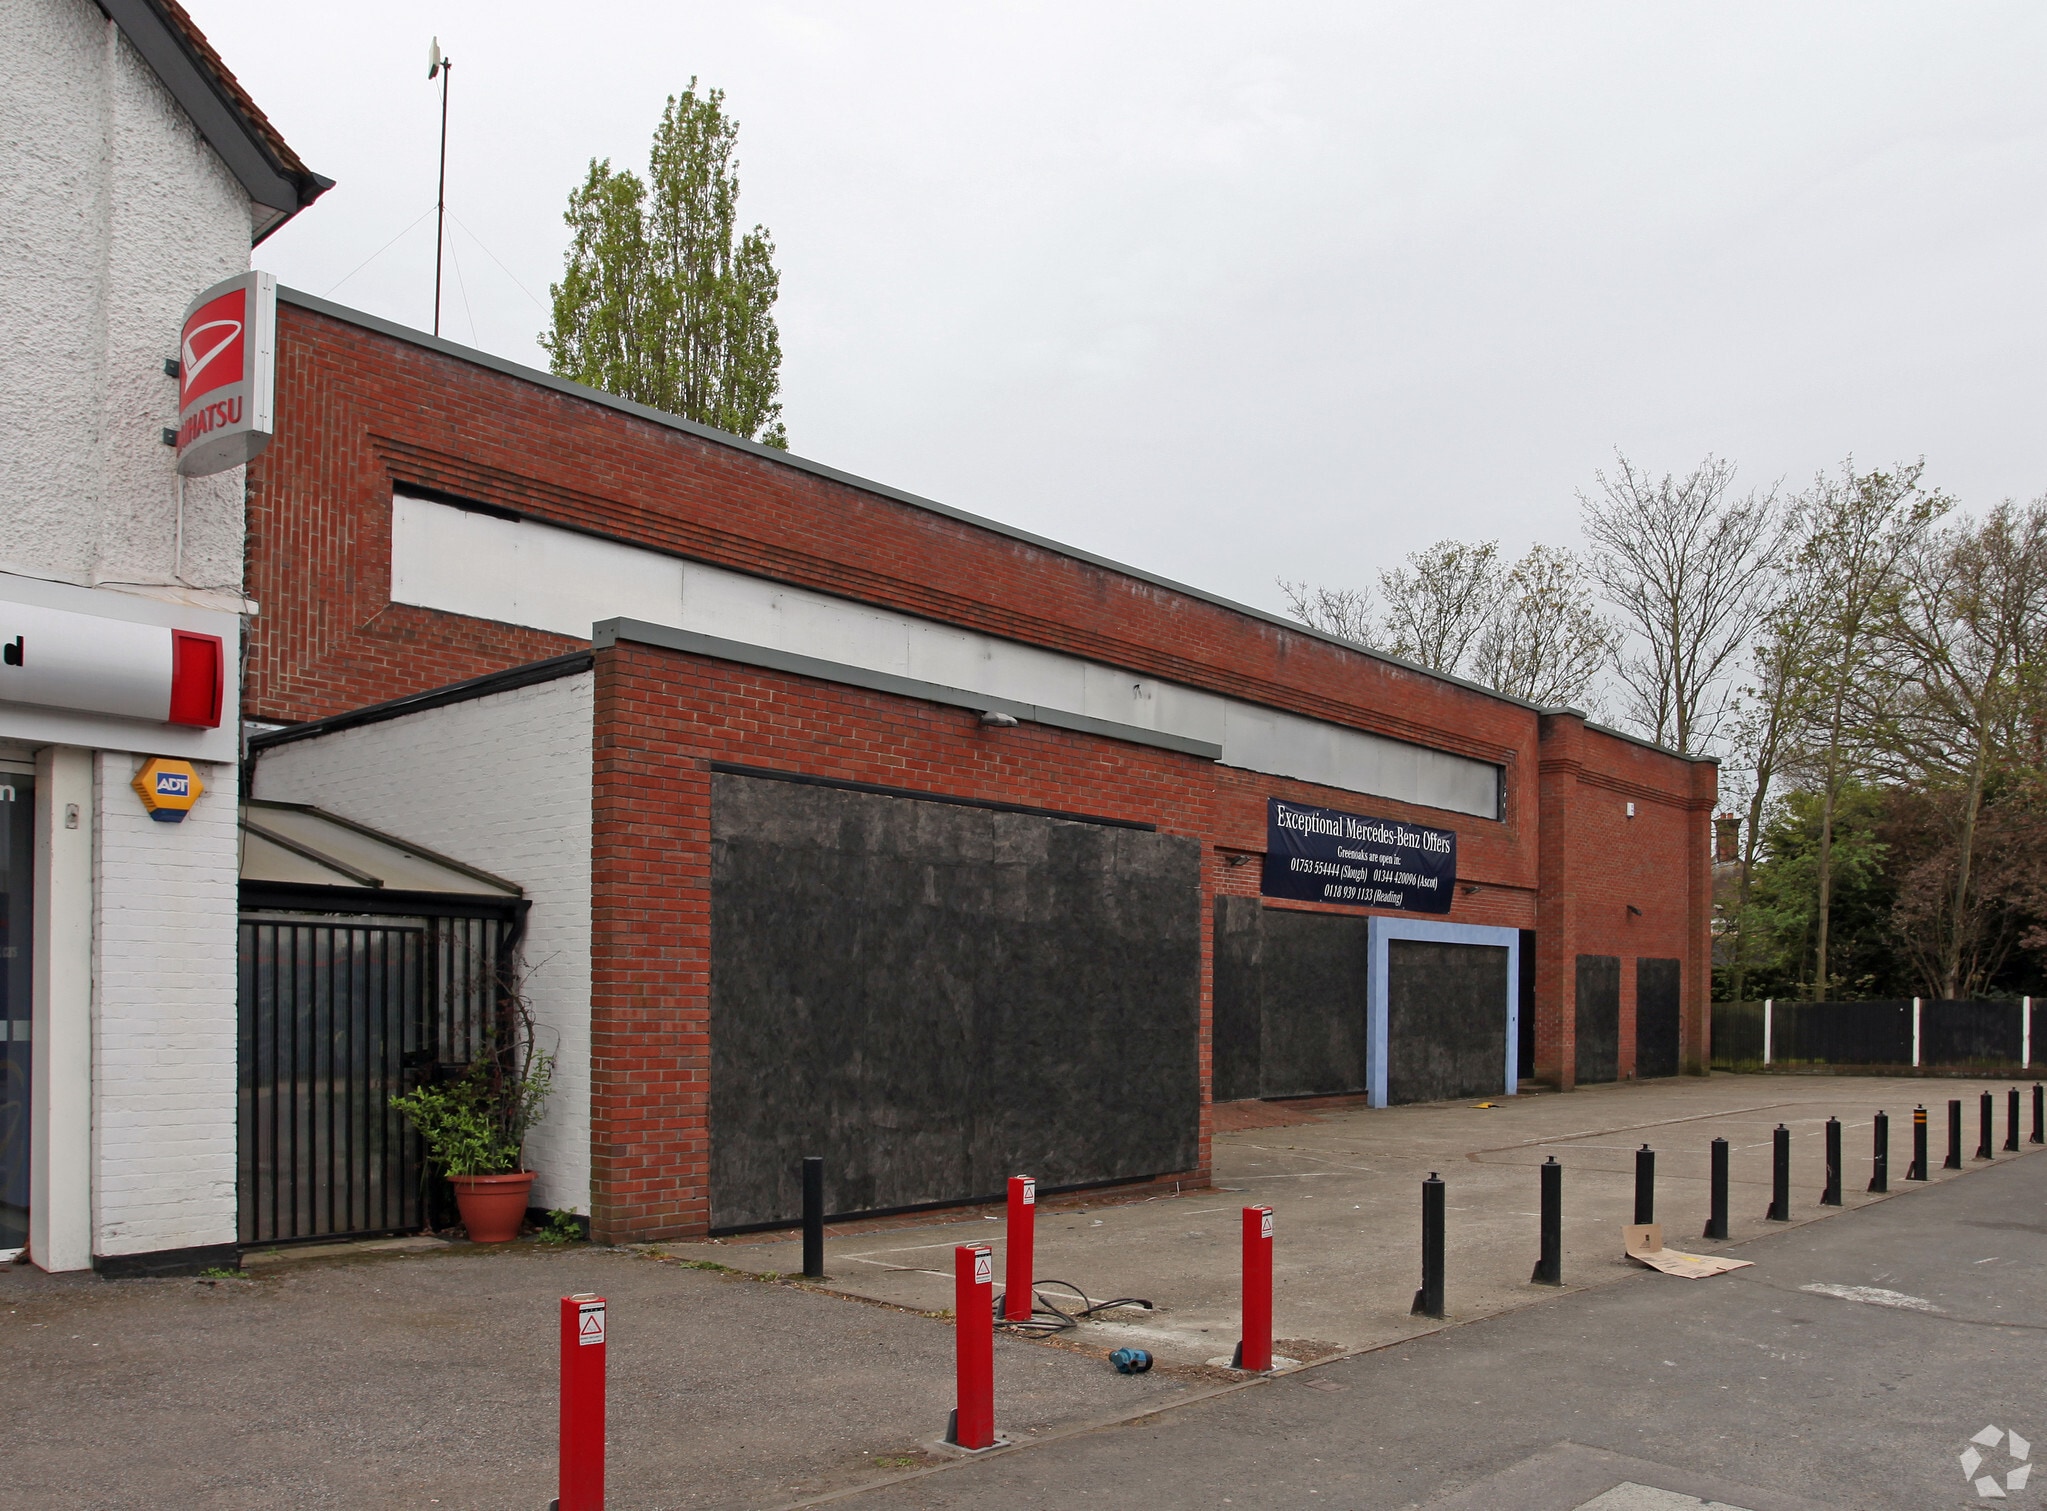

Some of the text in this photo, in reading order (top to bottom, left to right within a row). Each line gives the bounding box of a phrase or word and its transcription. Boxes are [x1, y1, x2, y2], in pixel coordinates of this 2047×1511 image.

[157, 776, 188, 793] ADT
[1277, 804, 1451, 854] Exceptional Mercedes-Benz Offers
[1337, 845, 1368, 861] Greenoaks
[1369, 852, 1379, 862] are
[1379, 854, 1393, 866] open
[1290, 857, 1313, 874] 01753
[1313, 861, 1340, 877] 554444
[1340, 864, 1368, 883] (Slough)
[1373, 868, 1394, 883] 01344
[1417, 874, 1438, 891] (Ascot)
[1324, 883, 1403, 907] 0118 939 1133 (Reading)
